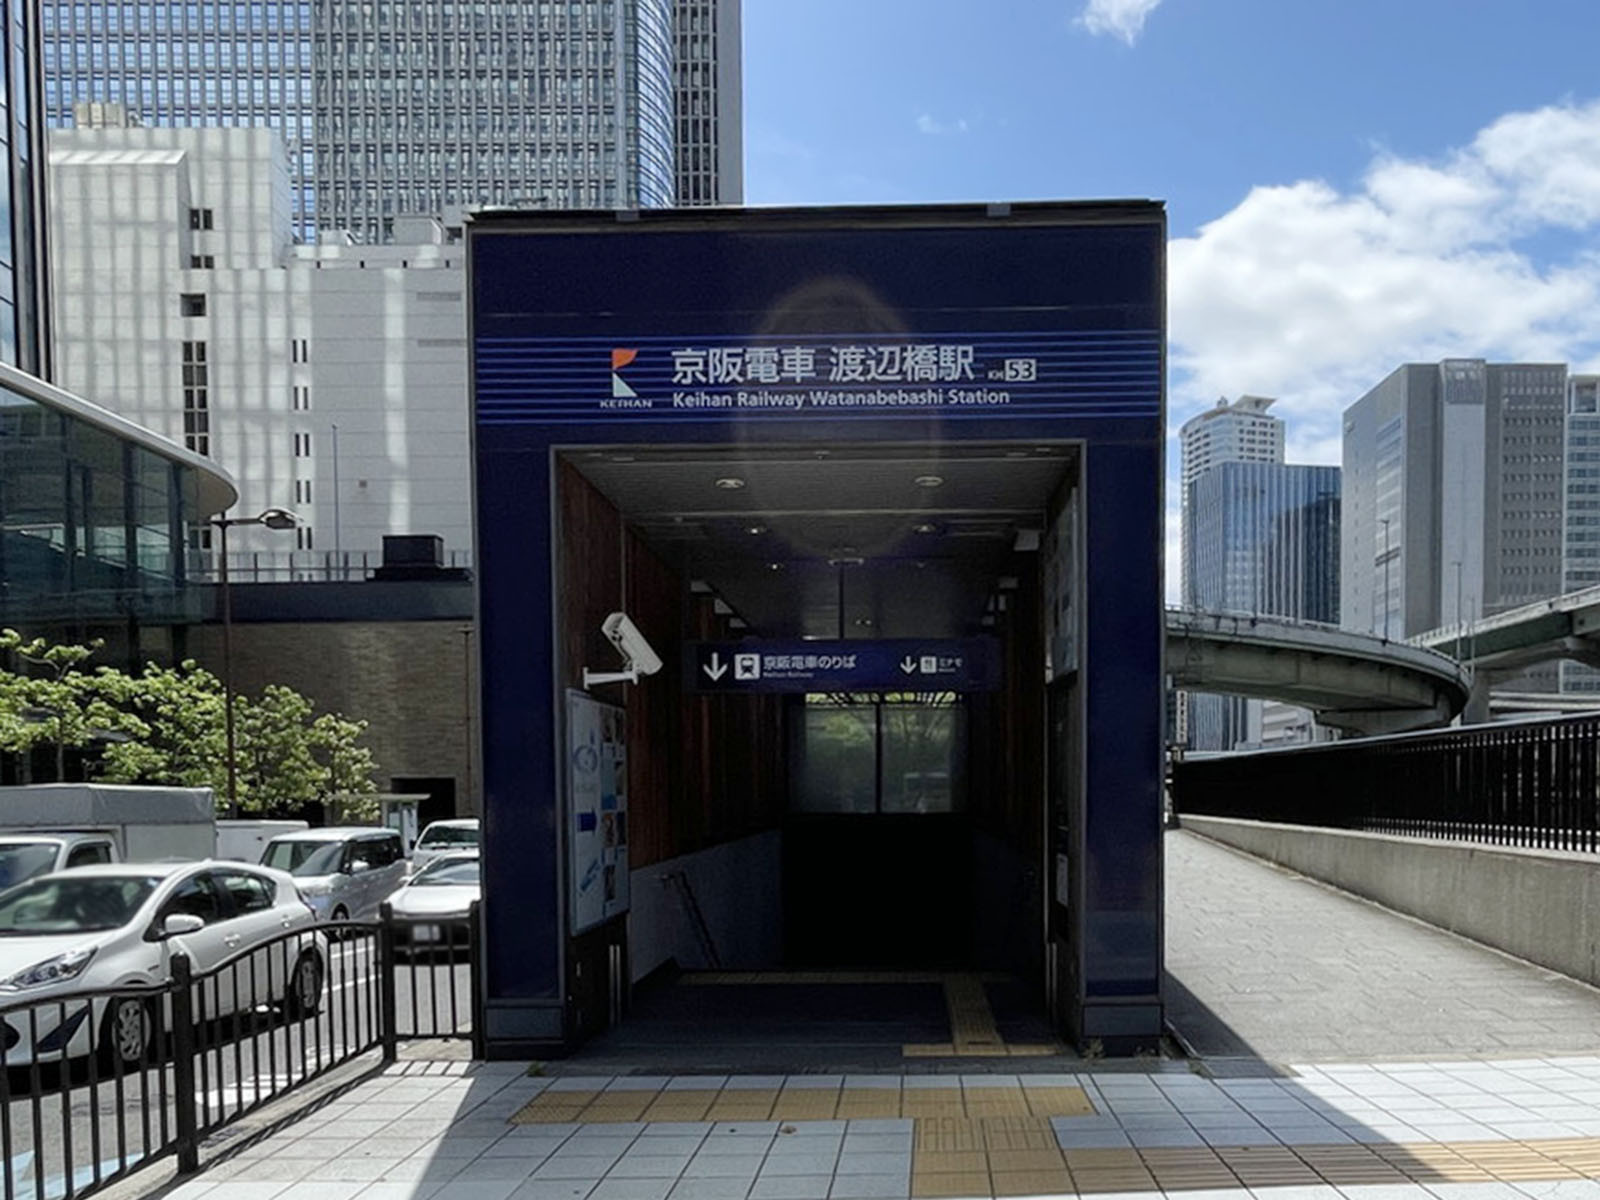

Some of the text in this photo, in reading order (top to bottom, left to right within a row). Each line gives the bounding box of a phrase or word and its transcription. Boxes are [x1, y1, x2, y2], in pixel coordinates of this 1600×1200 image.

[671, 345, 975, 384] 京阪電車 渡辺橋駅
[1007, 360, 1034, 380] 53
[600, 399, 652, 408] KEIHAN
[673, 388, 1010, 410] Keihan Railway Watanabebashi Station
